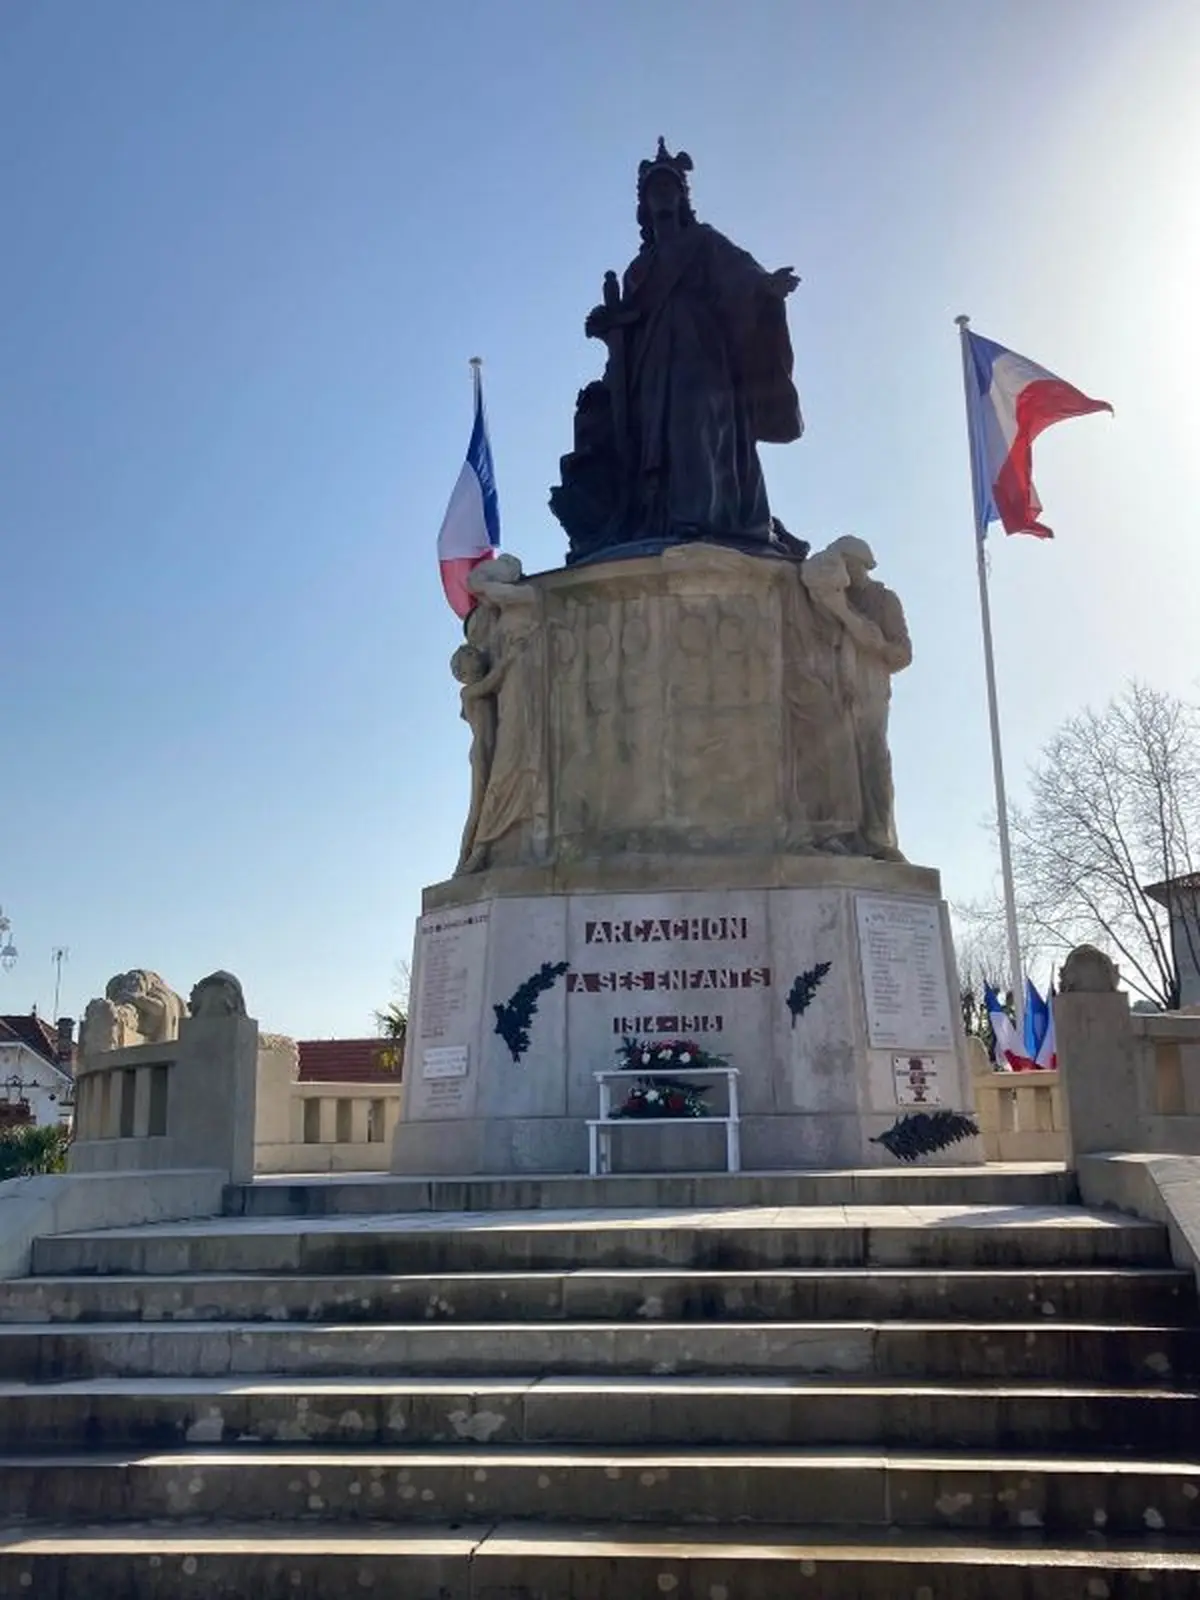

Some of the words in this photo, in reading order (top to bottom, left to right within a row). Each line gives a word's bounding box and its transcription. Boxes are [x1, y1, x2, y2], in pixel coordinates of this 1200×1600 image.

[590, 919, 744, 943] ARCACHON
[600, 971, 645, 992] SES
[656, 968, 766, 990] ENFANTS
